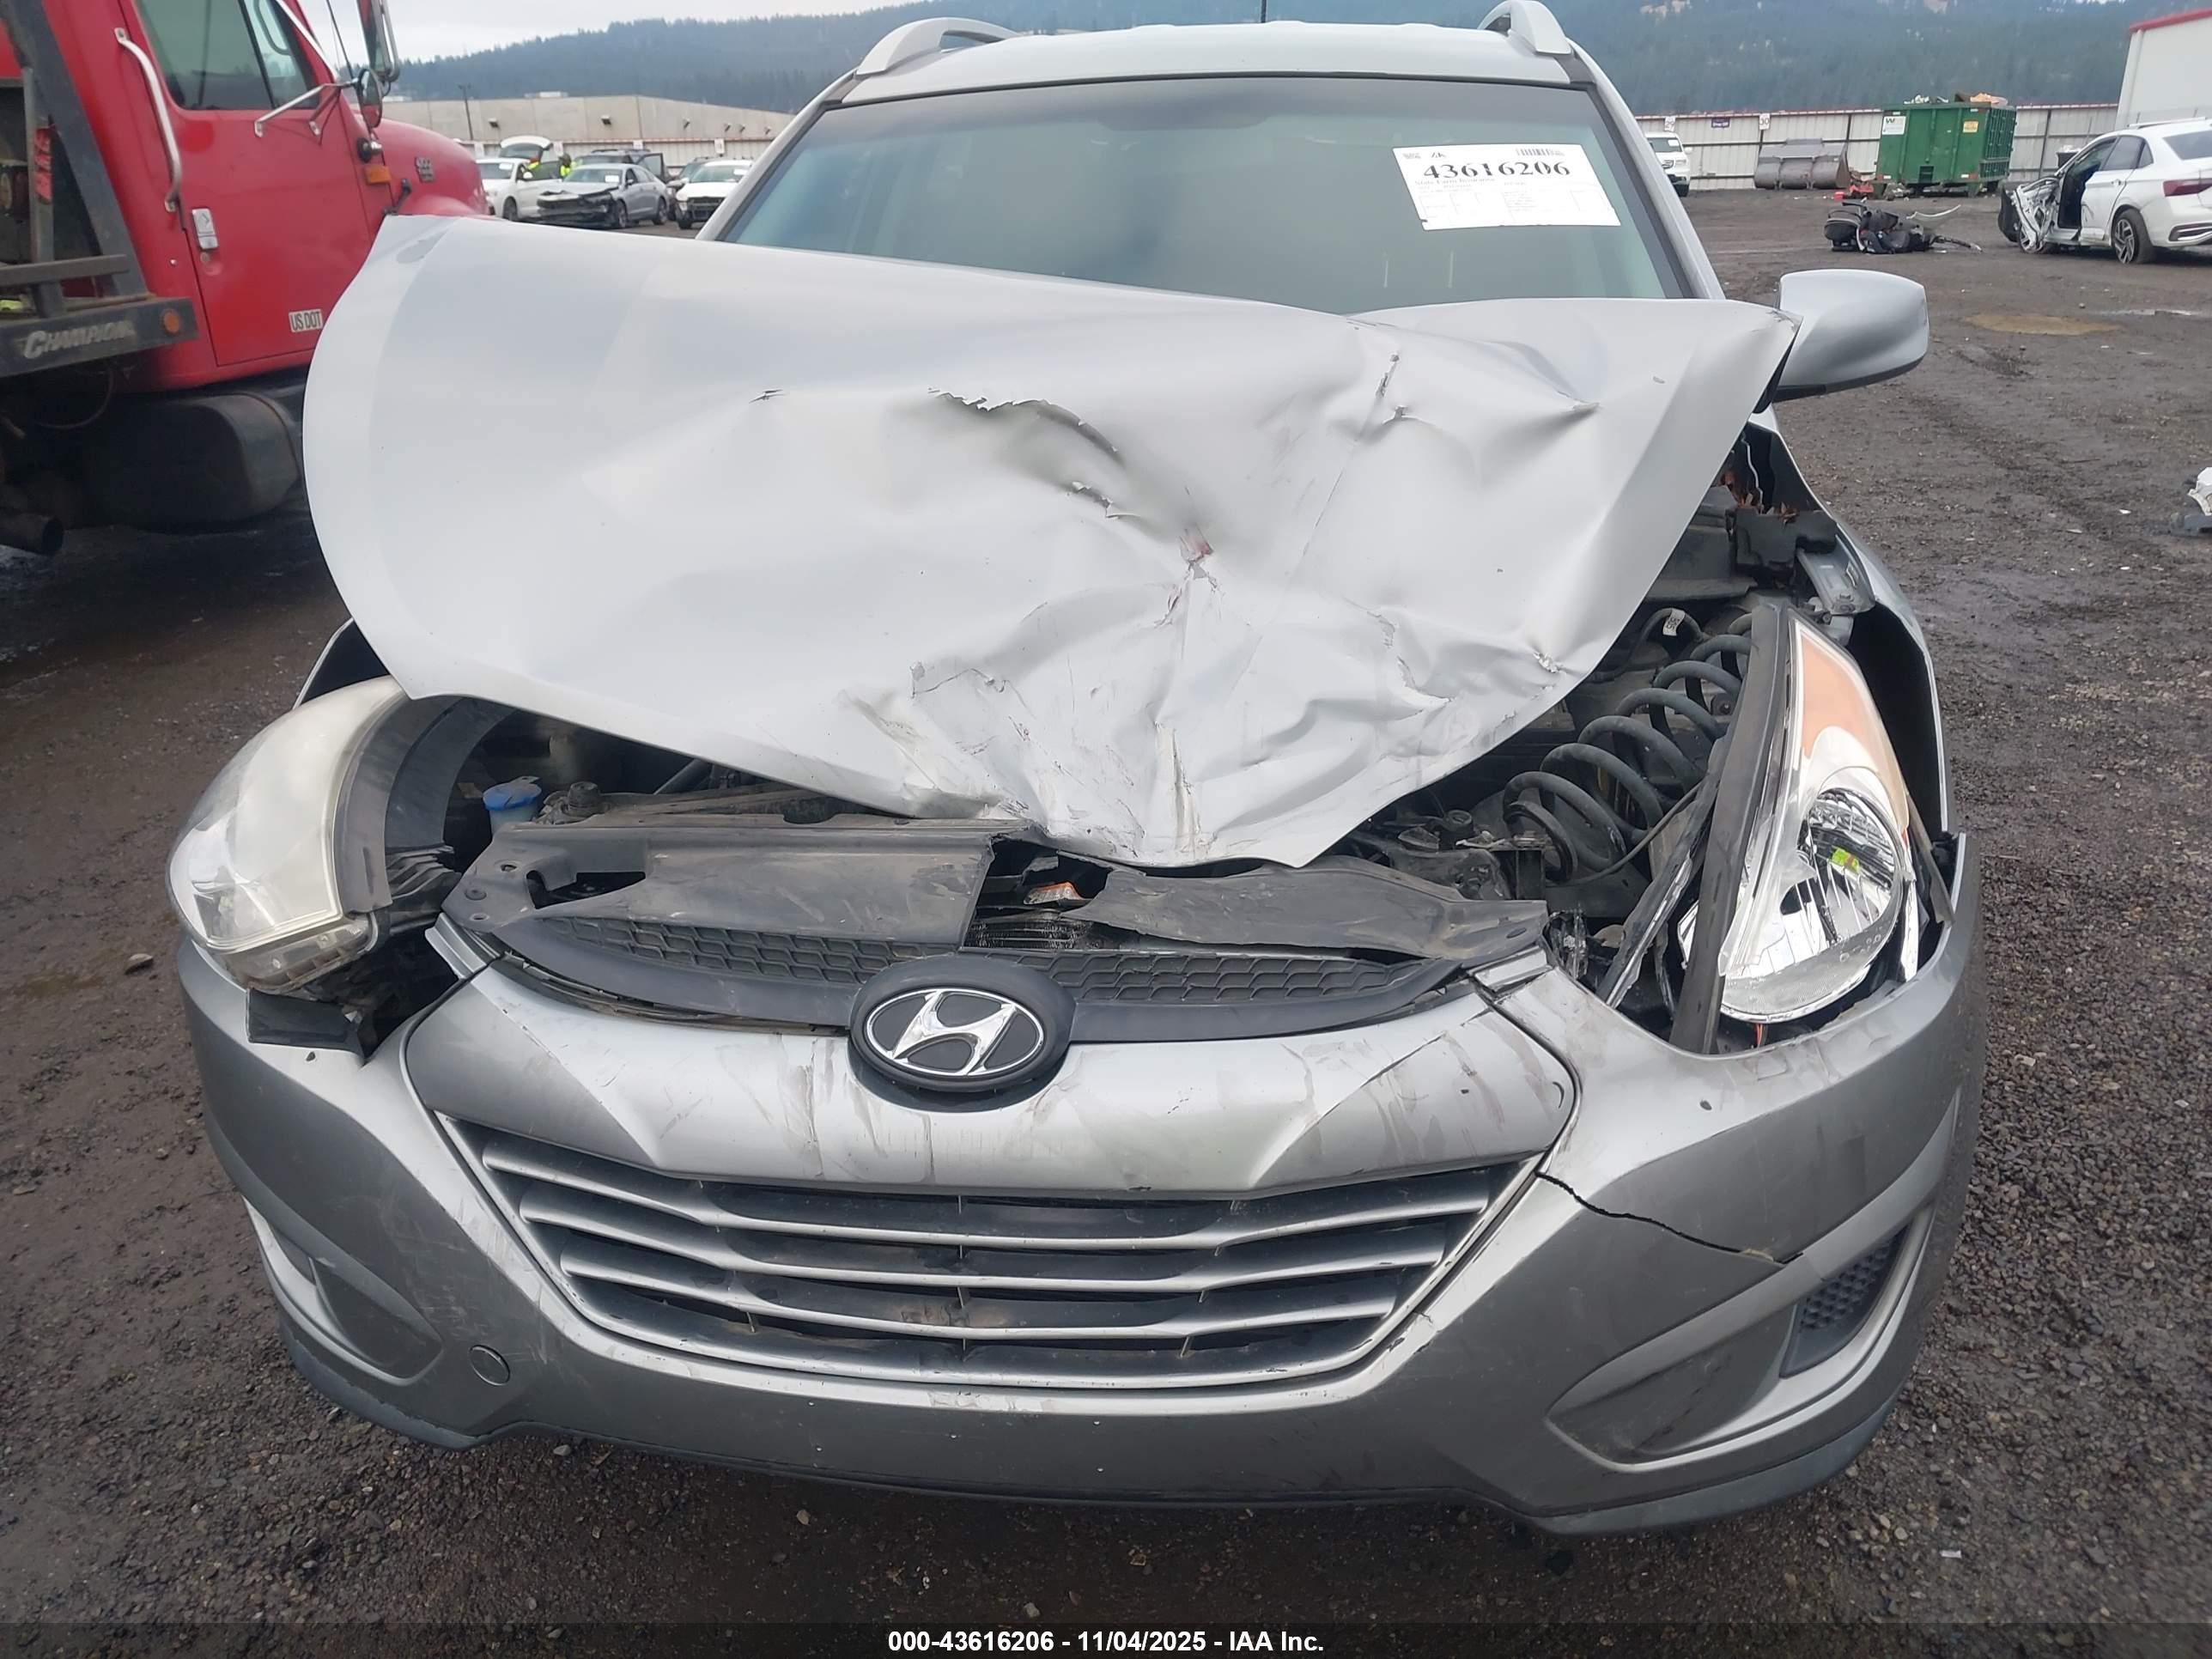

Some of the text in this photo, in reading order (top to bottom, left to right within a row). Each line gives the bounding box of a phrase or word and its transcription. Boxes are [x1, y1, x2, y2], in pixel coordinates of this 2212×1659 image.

[1423, 161, 1571, 179] 43616206
[290, 312, 320, 330] US DOT
